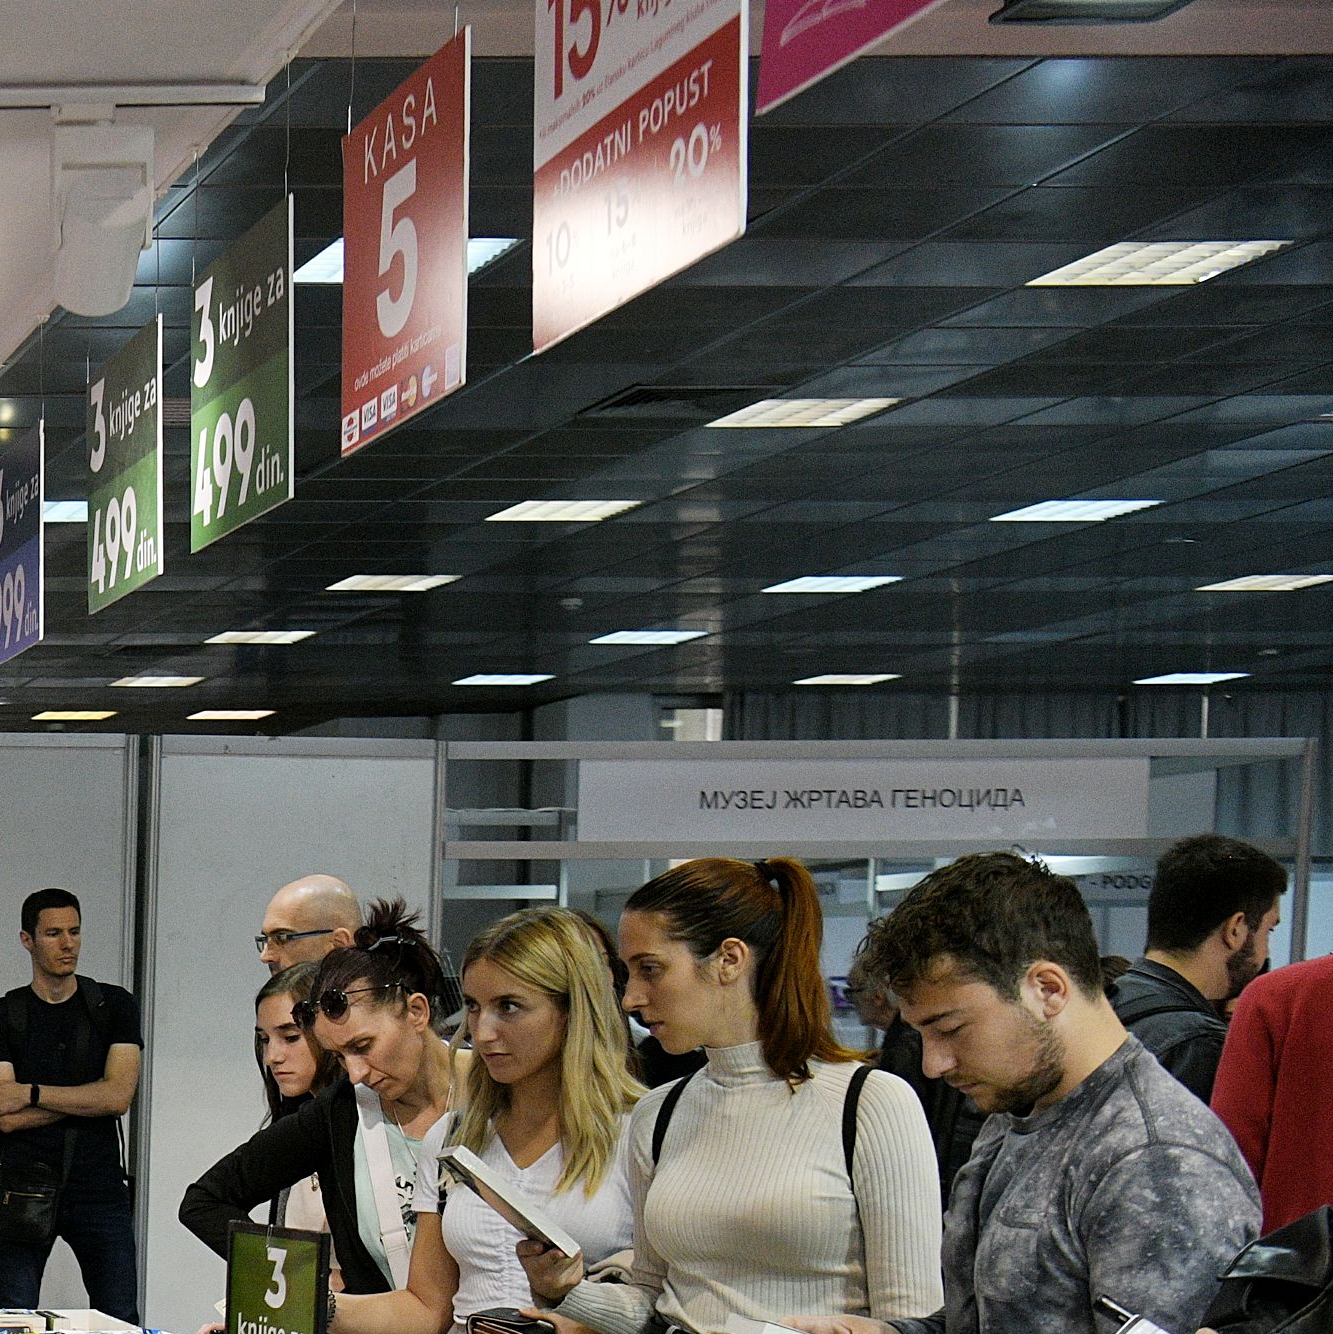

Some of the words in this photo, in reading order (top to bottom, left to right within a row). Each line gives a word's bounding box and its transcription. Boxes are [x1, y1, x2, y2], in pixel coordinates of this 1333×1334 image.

[363, 78, 437, 185] KASA
[639, 59, 713, 143] POPUST
[375, 158, 418, 338] 5
[194, 276, 214, 388] 3
[218, 285, 262, 346] knjige
[266, 266, 285, 305] za
[89, 378, 107, 472] 3
[108, 390, 142, 438] knjige
[142, 375, 157, 408] za
[364, 403, 376, 423] VISA
[383, 391, 396, 412] VISA
[5, 481, 28, 524] knjige
[28, 472, 39, 502] za
[192, 397, 256, 527] 499
[255, 447, 285, 496] din.
[91, 487, 137, 593] 499
[136, 525, 157, 571] din.
[700, 786, 777, 811] МУЗЕЈ
[785, 787, 884, 811] ЖРТАВА
[891, 786, 1026, 814] ГЕНОЦИДА
[264, 1246, 288, 1309] 3
